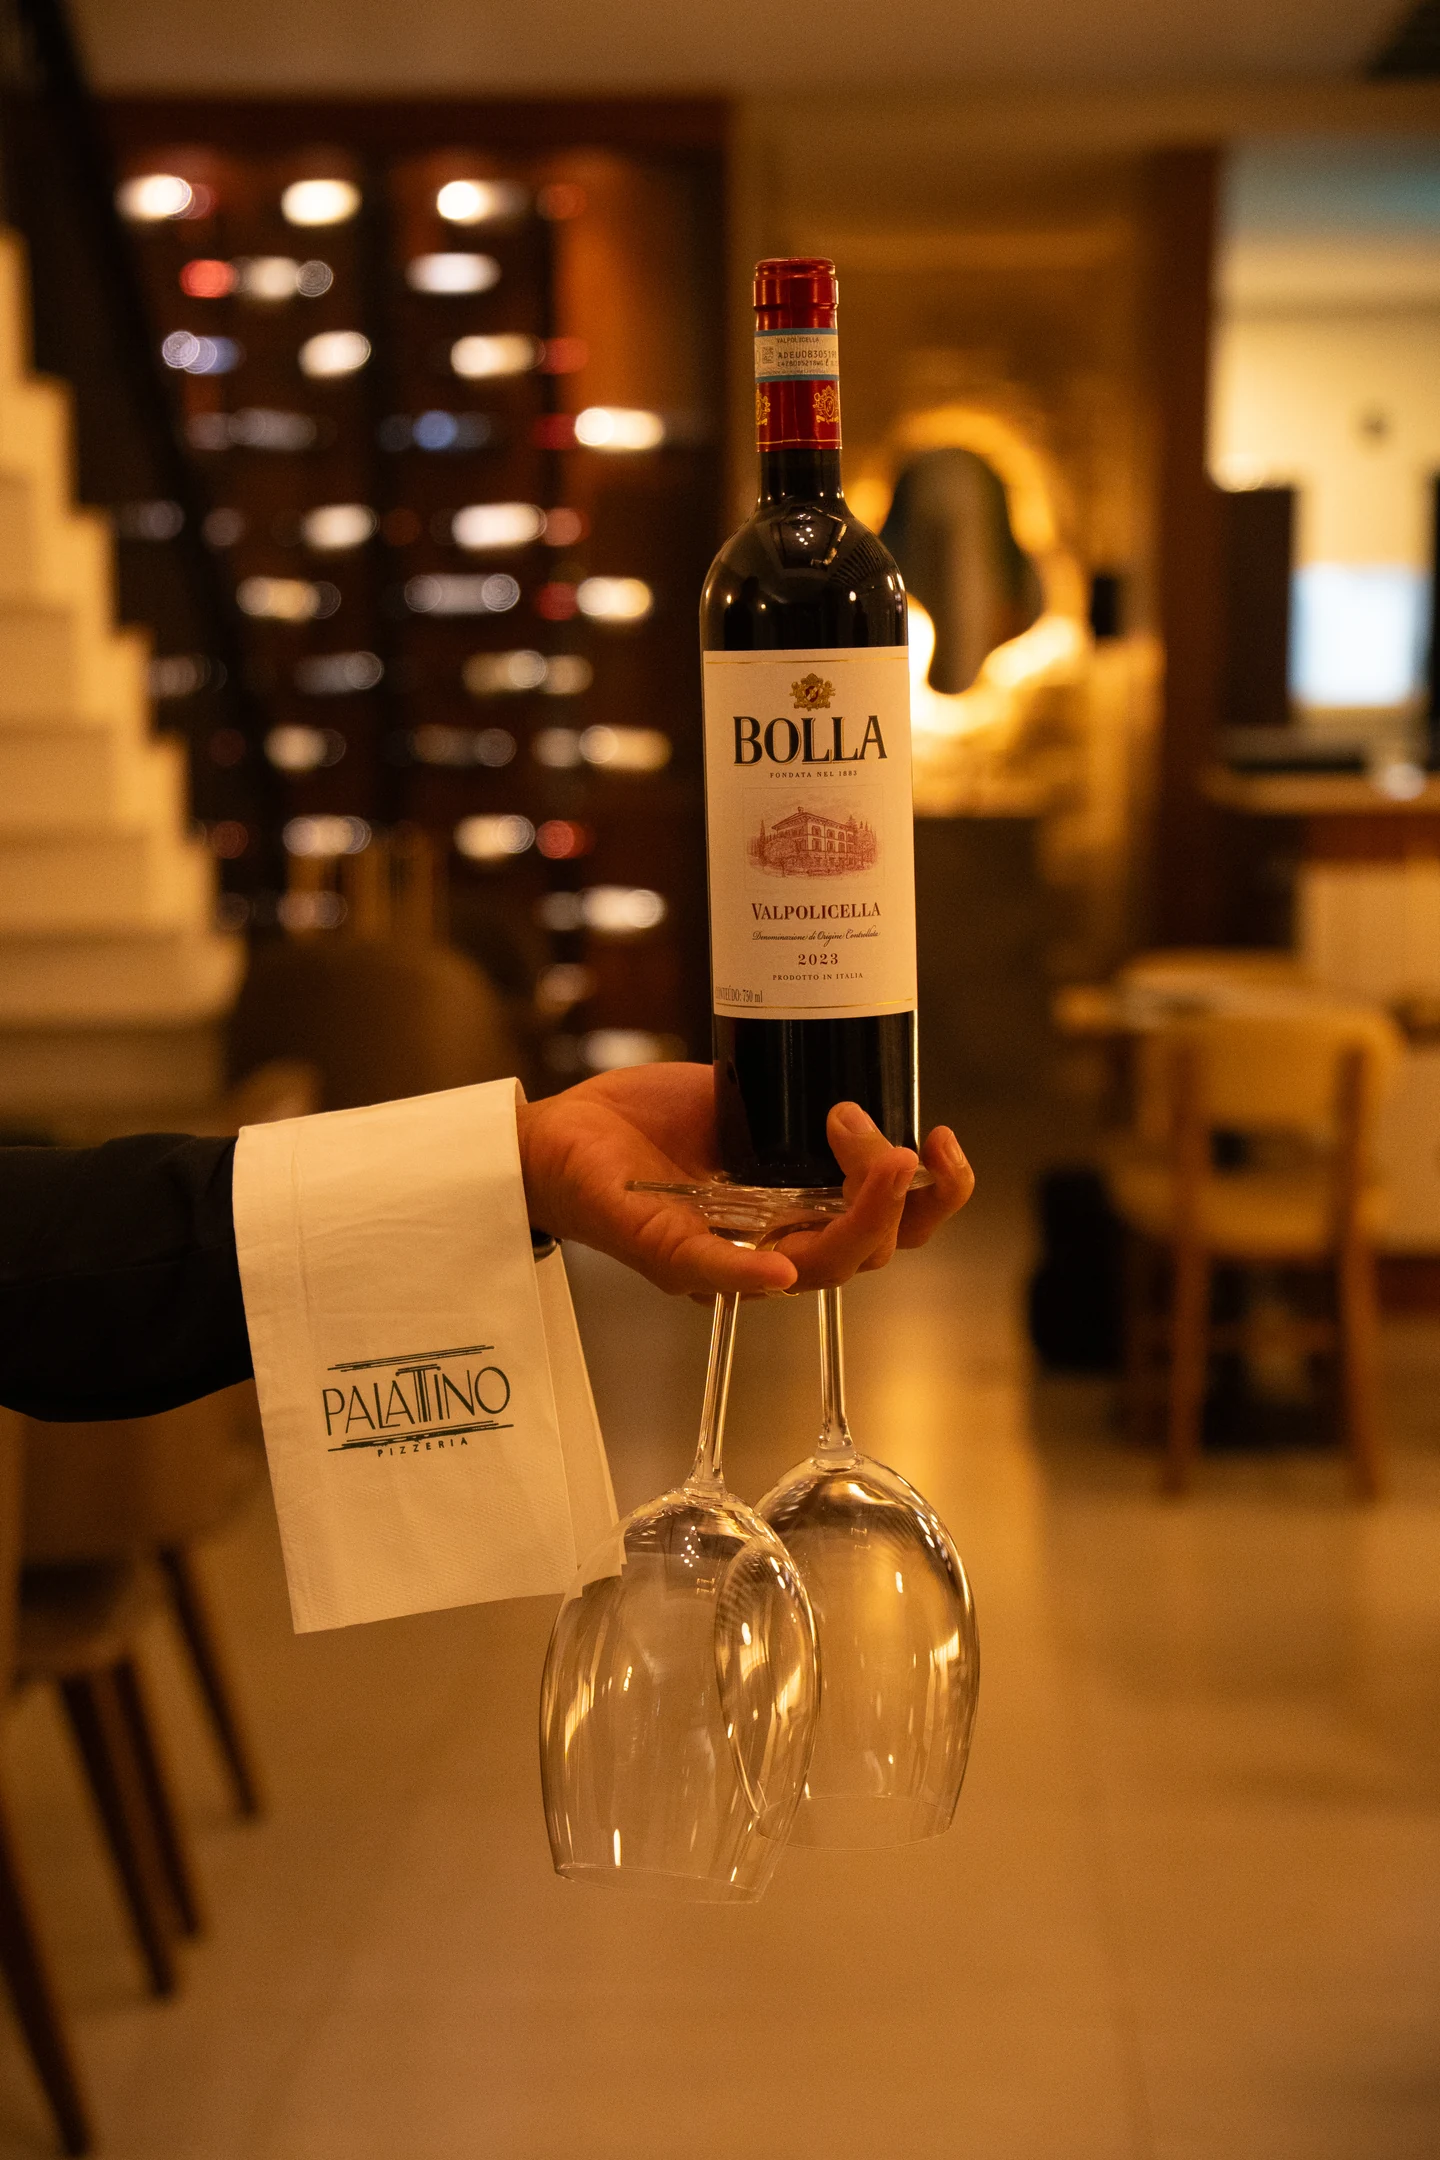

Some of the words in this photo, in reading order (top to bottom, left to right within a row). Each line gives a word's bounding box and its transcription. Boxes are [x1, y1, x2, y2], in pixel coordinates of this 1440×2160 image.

[733, 715, 888, 766] BOLLA
[751, 930, 807, 941] Denominazione
[808, 930, 817, 941] di
[817, 929, 844, 947] Origine
[845, 925, 880, 939] Controllata
[798, 953, 839, 965] 2023
[743, 989, 753, 1003] 750
[754, 990, 763, 1003] ml
[377, 1437, 468, 1457] PIZZERIA
